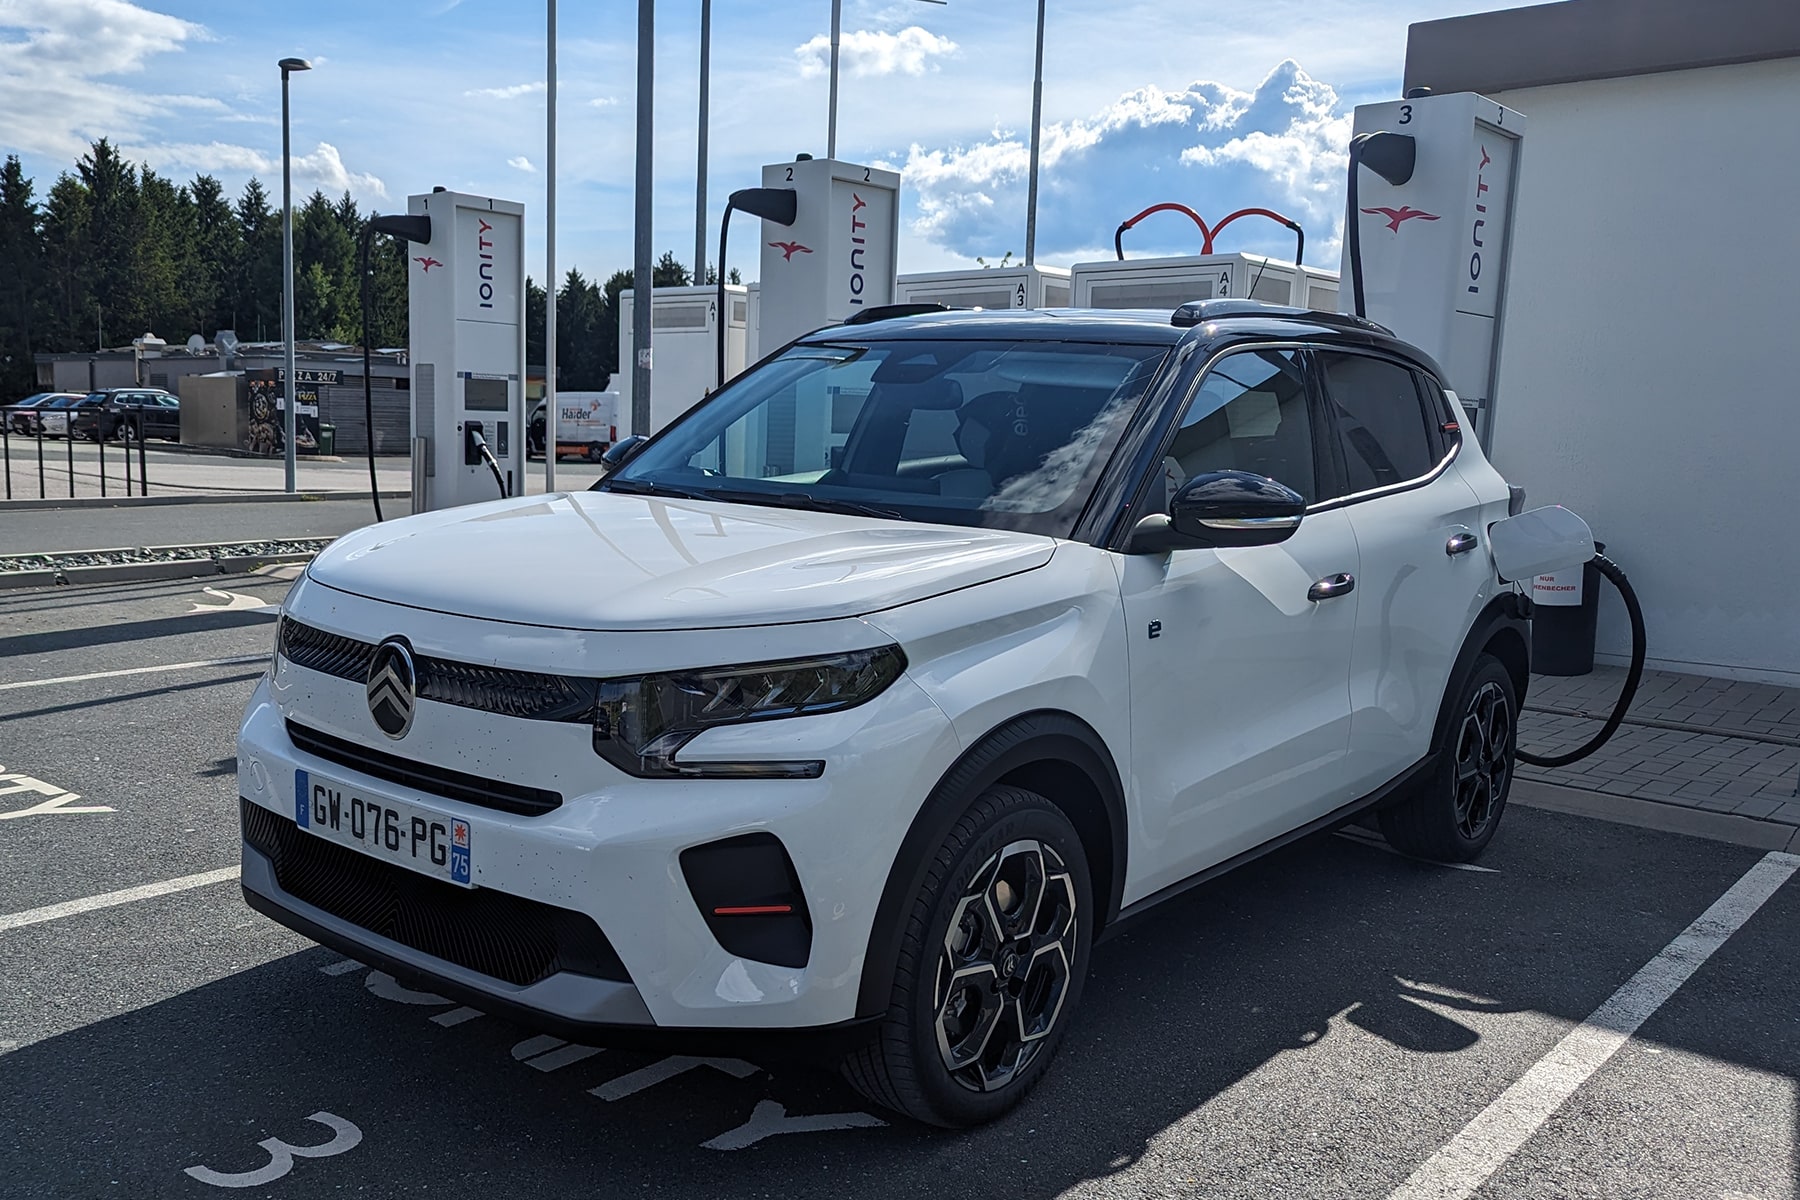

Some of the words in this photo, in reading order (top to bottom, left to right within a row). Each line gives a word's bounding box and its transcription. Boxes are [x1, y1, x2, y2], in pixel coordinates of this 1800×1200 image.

[1398, 105, 1413, 125] 3
[1497, 106, 1504, 125] 3
[785, 167, 794, 181] 2
[863, 167, 871, 182] 2
[423, 198, 428, 210] 1
[487, 198, 493, 210] 1
[1468, 144, 1491, 294] IONITY
[849, 192, 867, 305] IONITY
[479, 218, 493, 309] IONITY
[278, 371, 312, 381] PZA
[317, 372, 336, 383] 24/7
[300, 804, 305, 816] F
[313, 784, 447, 866] GW-076-PG
[453, 852, 468, 876] 75
[184, 1111, 362, 1188] 3
